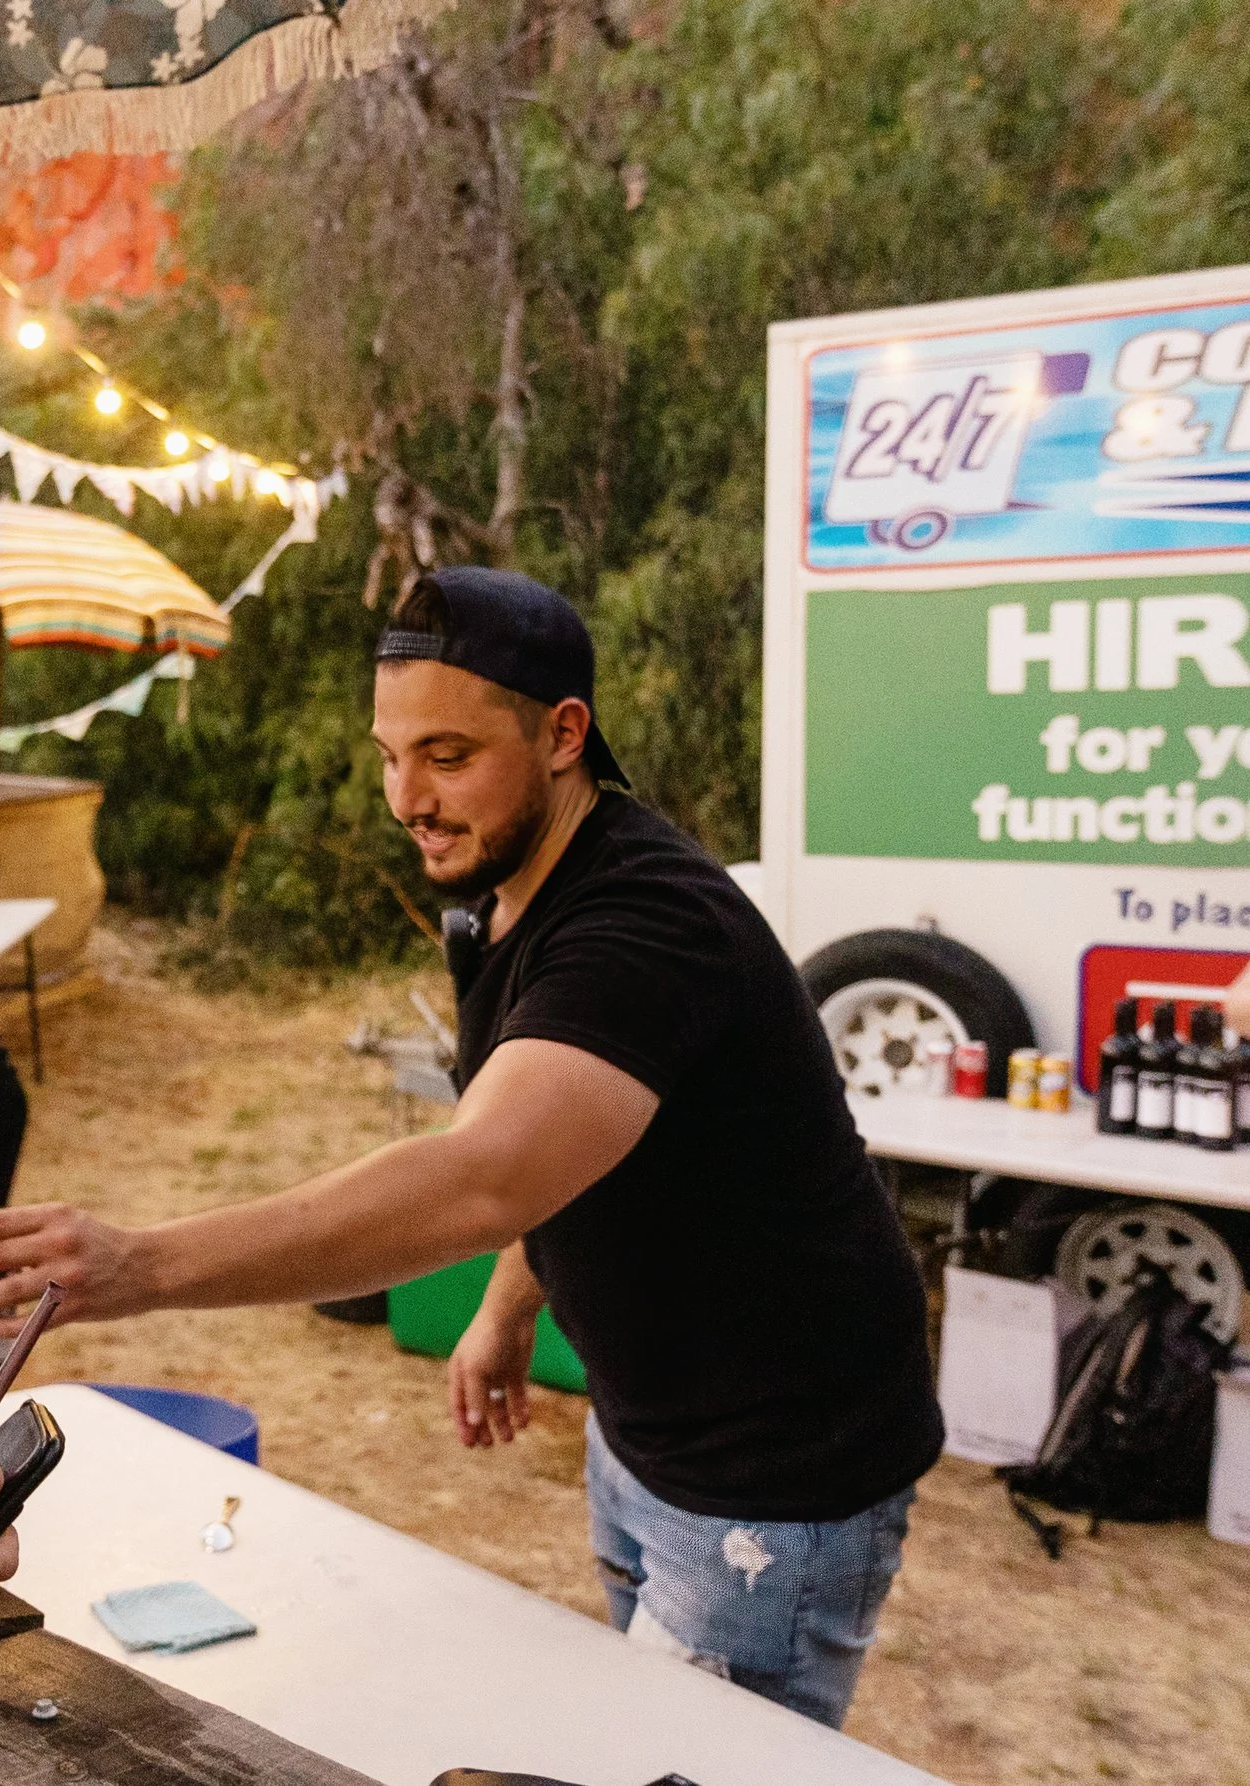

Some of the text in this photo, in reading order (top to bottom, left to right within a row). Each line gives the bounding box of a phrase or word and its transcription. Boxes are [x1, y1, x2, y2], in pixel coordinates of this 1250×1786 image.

[844, 374, 1025, 483] 24/7
[1102, 394, 1212, 462] &
[988, 594, 1250, 695] HIR
[1039, 713, 1250, 780] for y
[972, 780, 1250, 845] functio
[1115, 887, 1153, 921] To
